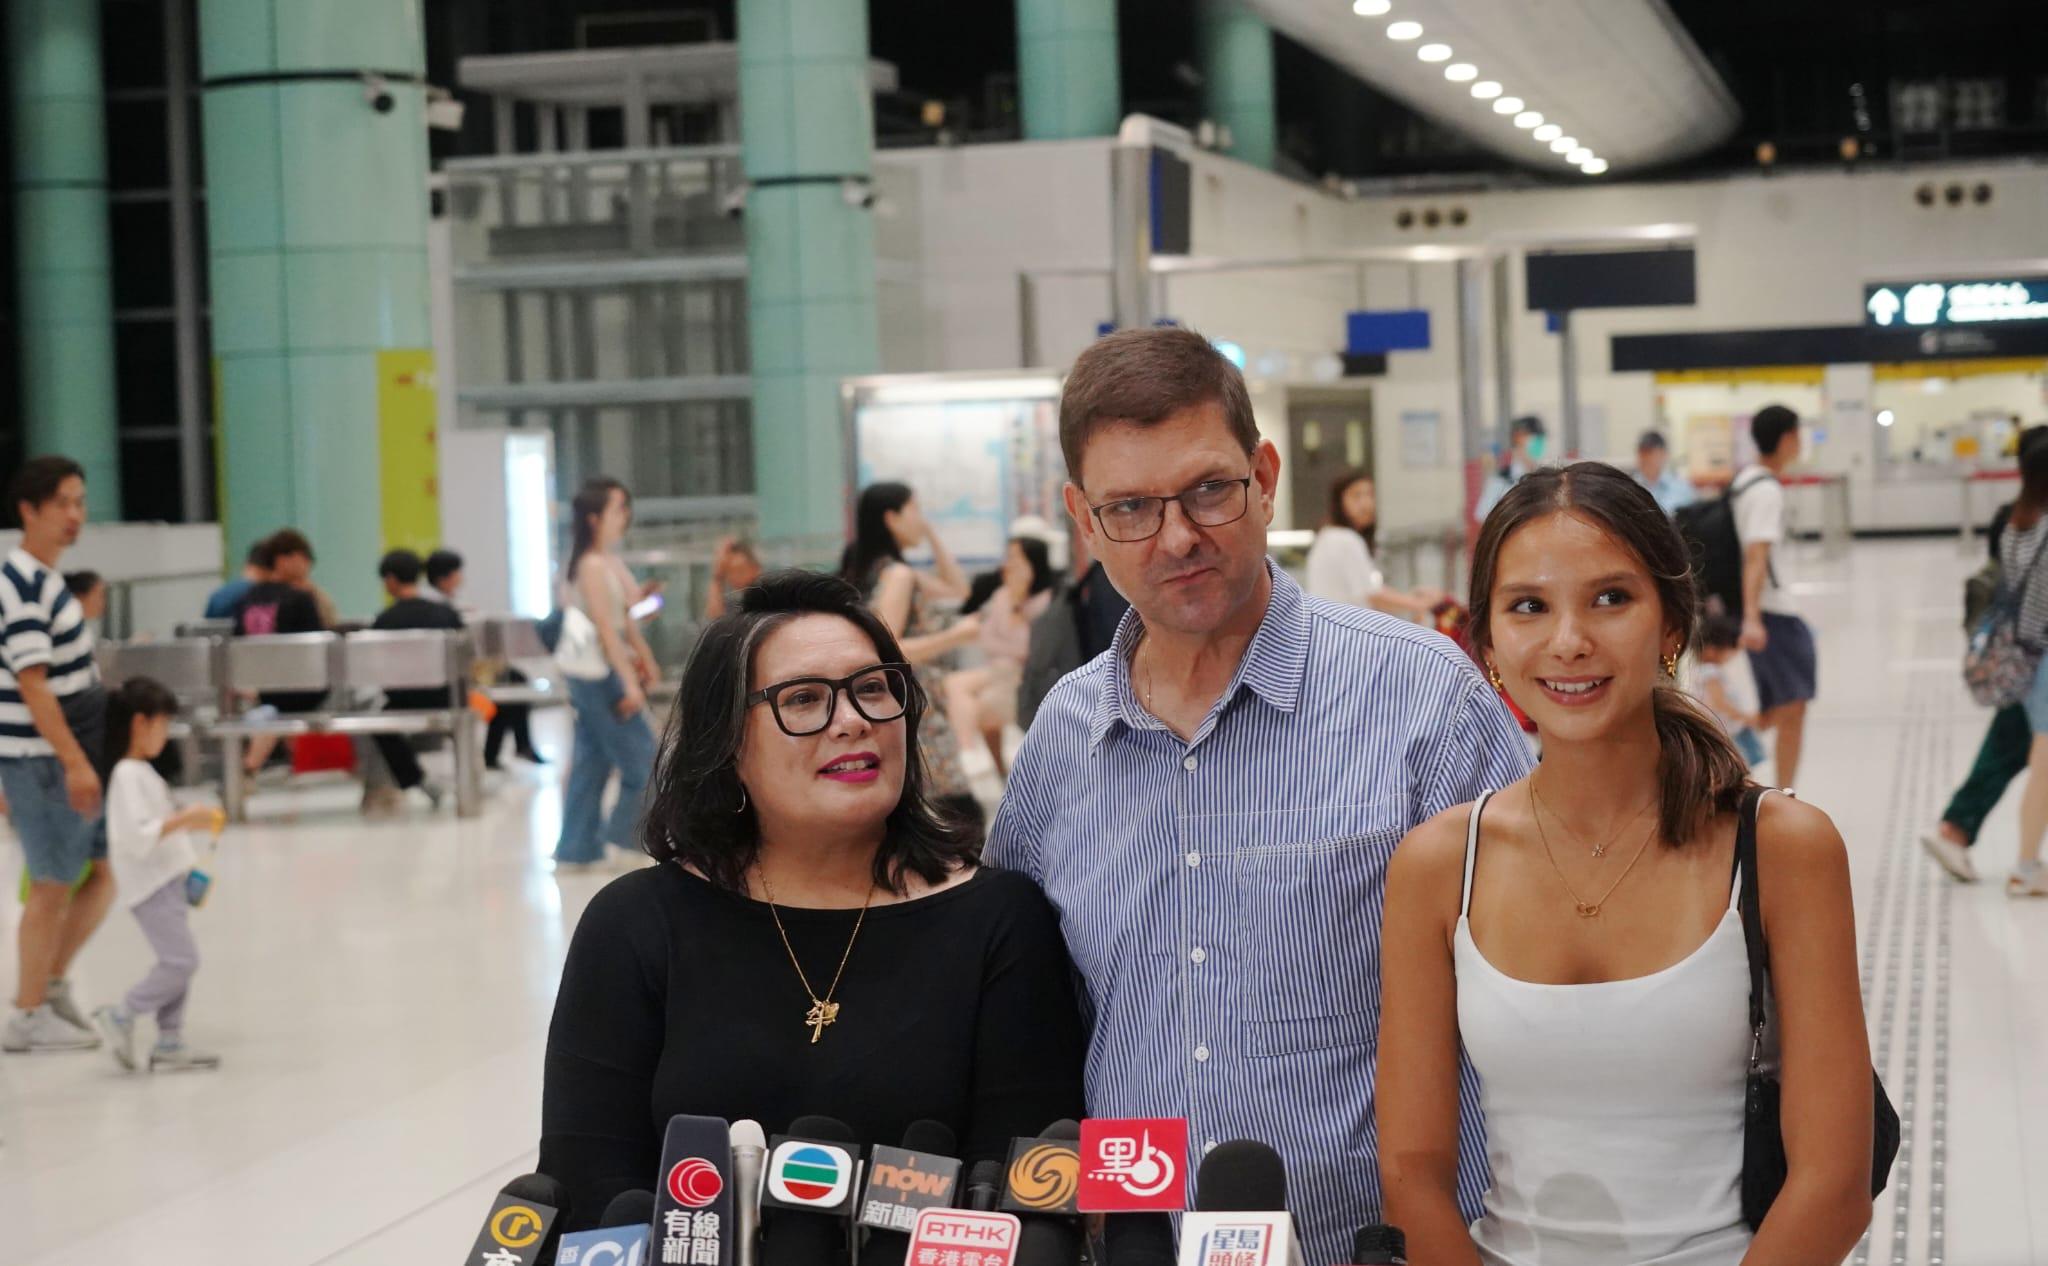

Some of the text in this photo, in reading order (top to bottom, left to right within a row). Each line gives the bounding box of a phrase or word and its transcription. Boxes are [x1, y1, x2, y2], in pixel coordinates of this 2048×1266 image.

[873, 1158, 951, 1200] now
[663, 1209, 720, 1239] 有線
[863, 1200, 918, 1231] 新聞
[926, 1221, 1007, 1242] RTHK
[1211, 1229, 1260, 1250] 星島
[662, 1237, 720, 1266] 新聞
